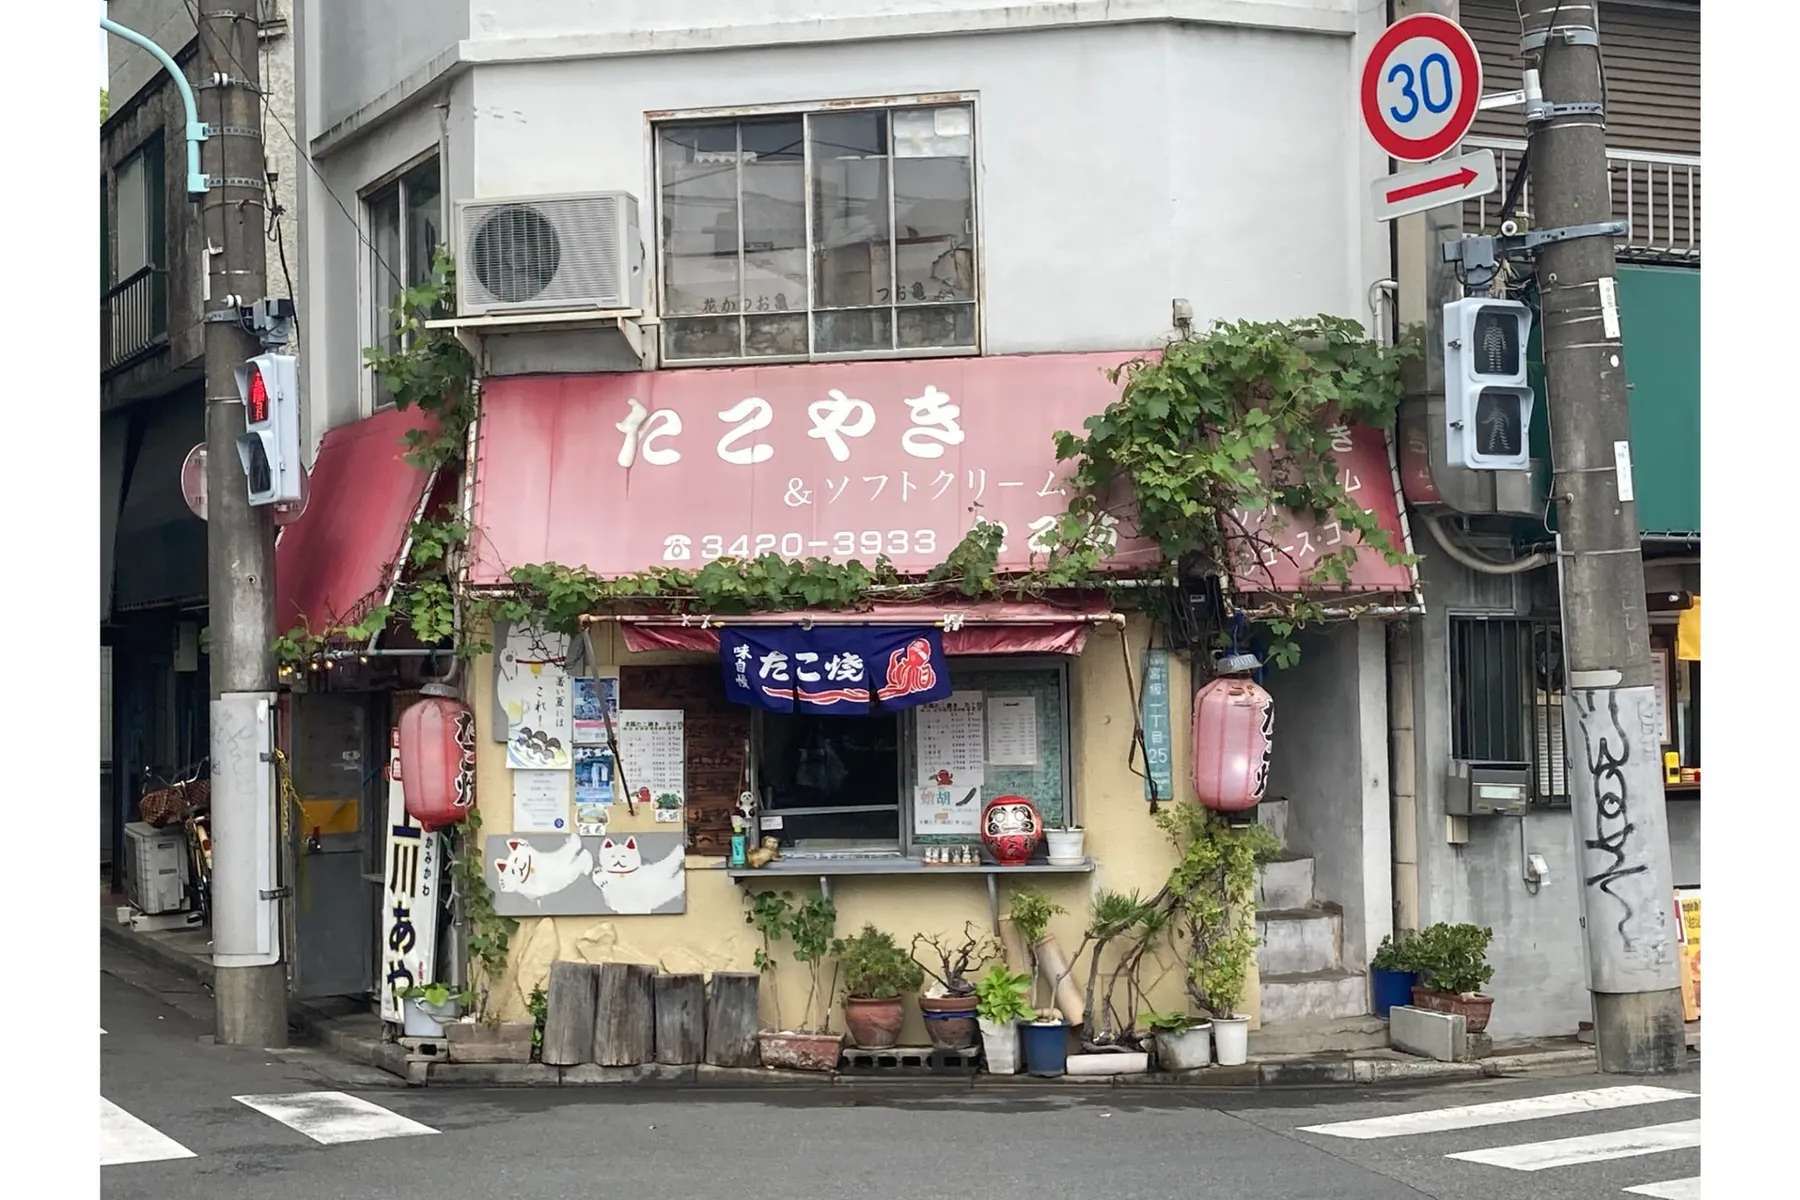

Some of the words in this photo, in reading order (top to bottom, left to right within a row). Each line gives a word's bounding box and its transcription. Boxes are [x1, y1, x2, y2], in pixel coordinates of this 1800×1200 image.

[1388, 53, 1453, 123] 30
[615, 385, 965, 467] たこやき
[701, 529, 937, 559] 3420-3933
[1148, 748, 1168, 764] 25
